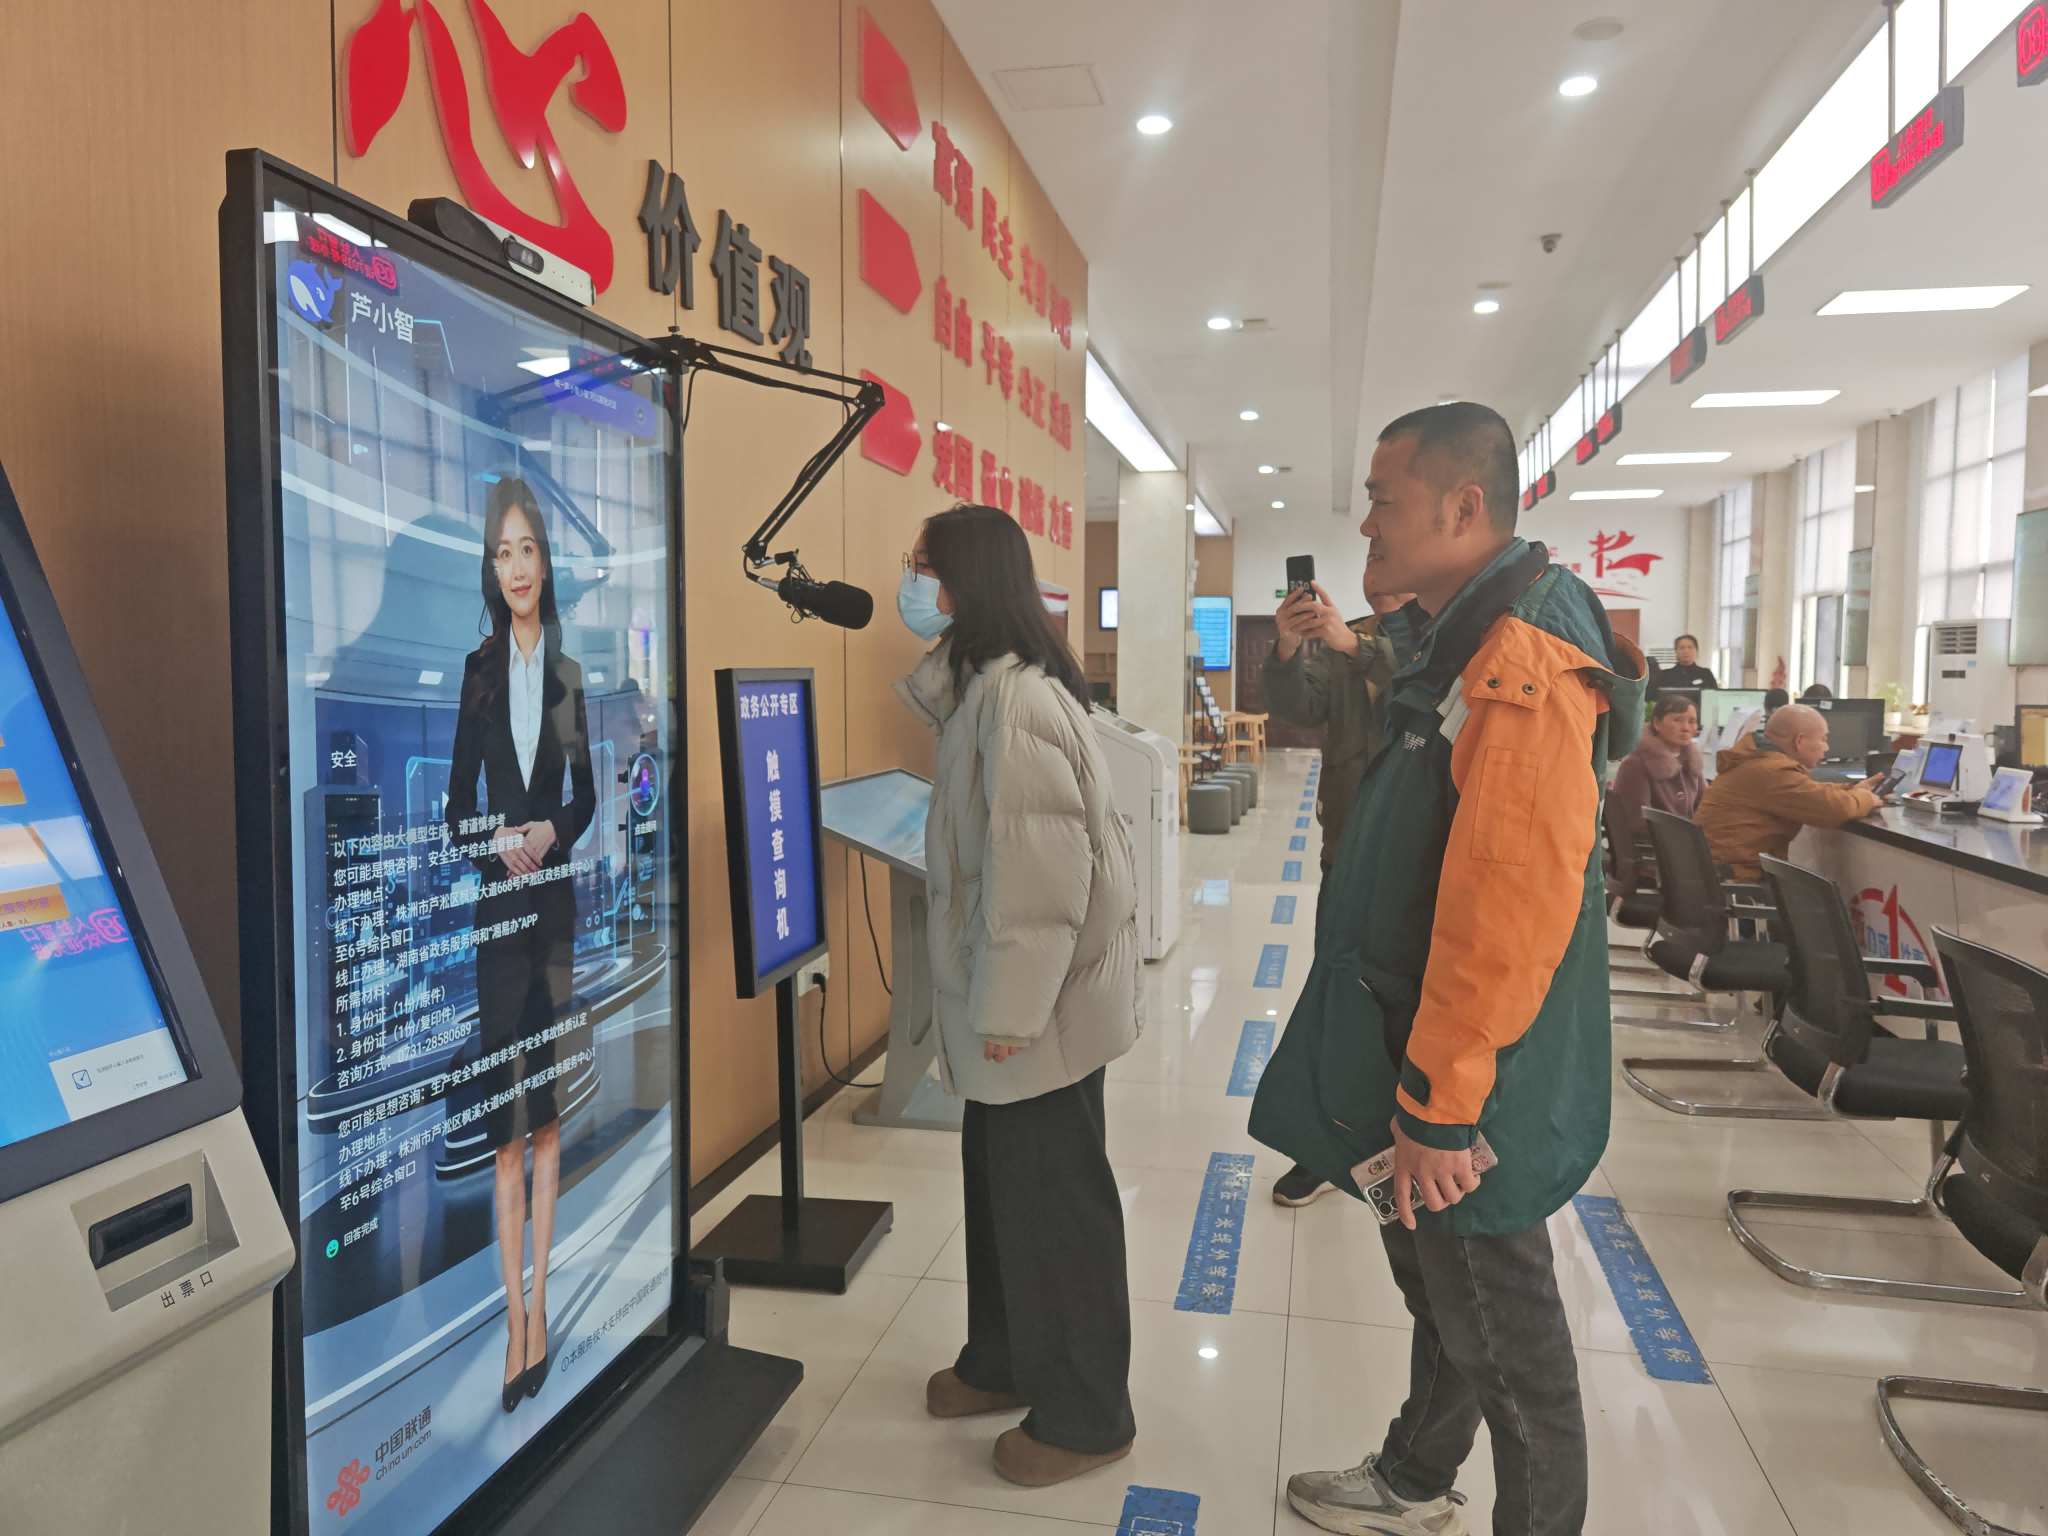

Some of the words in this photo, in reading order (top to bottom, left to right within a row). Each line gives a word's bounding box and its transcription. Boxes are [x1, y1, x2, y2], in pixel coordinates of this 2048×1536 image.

[2022, 18, 2041, 64] 08
[932, 120, 973, 231] 富强
[981, 186, 1013, 281] 民主
[638, 158, 812, 369] 价值观
[351, 292, 413, 344] 芦小智
[934, 275, 972, 367] 自由
[981, 320, 1013, 400] 平等
[1018, 366, 1045, 428] 公正
[932, 420, 973, 503] 爱国
[740, 692, 799, 720] 政务公开专区
[331, 750, 357, 768] 安全
[766, 749, 790, 941] 触摸查询机
[334, 885, 389, 912] 办理地点：
[335, 927, 414, 963] 至6号综合窗口
[336, 983, 390, 1014] 所需材料：
[338, 1126, 392, 1165] 办理地点：
[340, 1161, 416, 1212] 至6号综合窗口
[343, 1217, 379, 1247] 回答完成
[161, 1271, 213, 1308] 出票口
[375, 1405, 431, 1463] 中国联通
